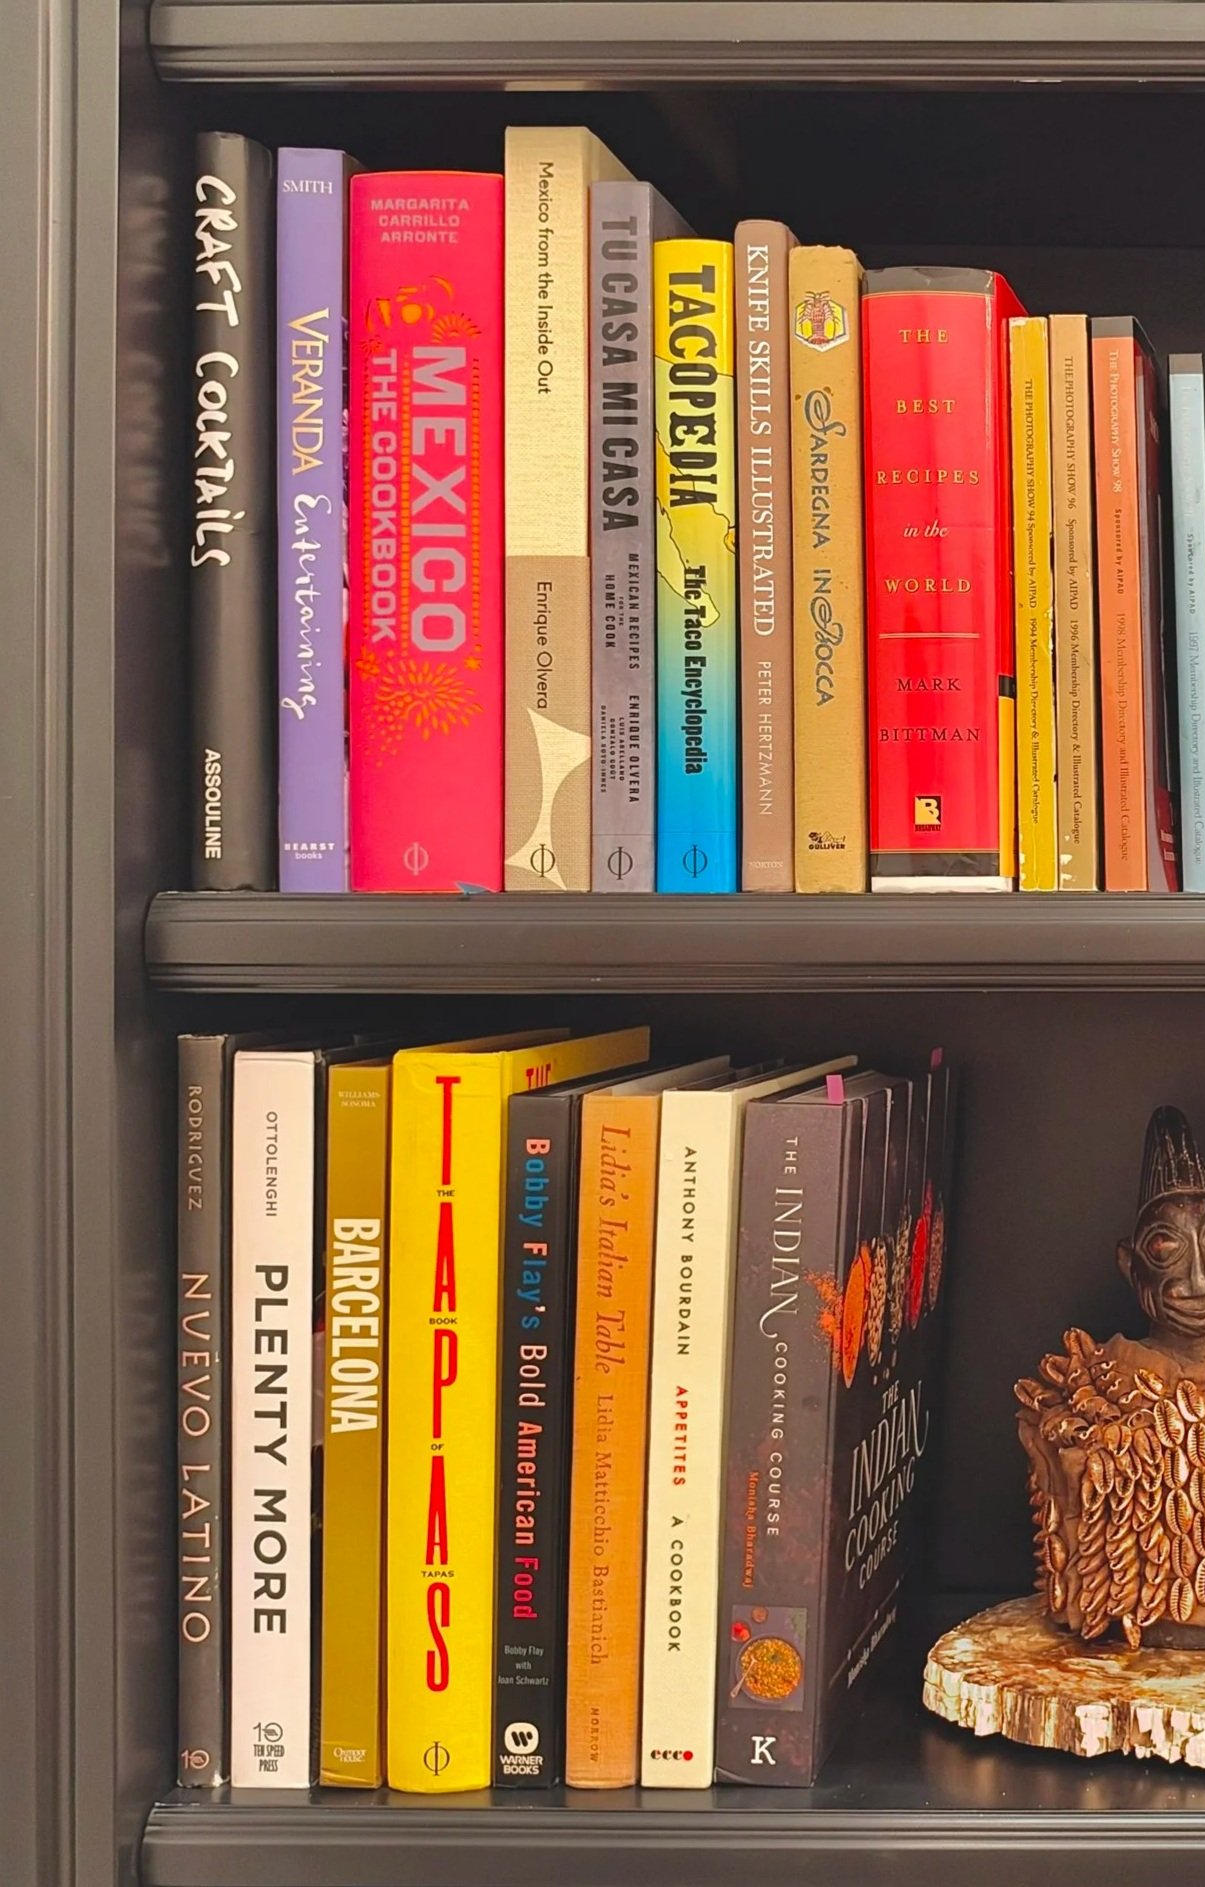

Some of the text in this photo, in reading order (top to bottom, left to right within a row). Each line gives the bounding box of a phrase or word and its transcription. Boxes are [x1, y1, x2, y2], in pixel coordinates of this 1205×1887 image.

[283, 180, 334, 195] SMITH
[371, 198, 470, 212] MARGARITA
[379, 214, 460, 228] CARRILLO
[381, 231, 458, 245] ARRONTE
[194, 175, 242, 328] CRAFT
[537, 162, 554, 396] Mexico from the Inside Out
[601, 216, 640, 532] TU CASA MI CASA
[668, 265, 719, 509] TACOPEDIA
[899, 329, 950, 344] THE
[747, 244, 775, 637] KNIFE SKILLS ILLUSTRATED
[897, 399, 956, 415] BEST
[281, 308, 332, 721] VERANDA Entertaining
[372, 349, 397, 643] THE COOKBOOK
[412, 346, 467, 653] MEXICO
[877, 470, 980, 486] RECIPES
[903, 519, 950, 538] in the
[804, 390, 847, 707] SARDEGNA IN BOCCA
[885, 578, 972, 594] WORLD
[1065, 356, 1083, 844] THE PHOTOGRAPHY SHOW 96 Sponsored by AIPAD 1996 Membership Directory & Illustrated Catalogue
[533, 581, 553, 710] Enrique Olvera
[605, 575, 617, 649] HOME COOK
[628, 553, 640, 671] MEXICAN RECIPES
[681, 565, 708, 775] The Taco Encyclopedia
[757, 661, 773, 816] PETER HERTZMANN
[880, 728, 981, 743] BITTMAN
[897, 677, 962, 692] MARK
[204, 749, 222, 860] ASSOULINE
[629, 695, 641, 804] ENRIQUE OLVERA
[265, 1111, 279, 1217] OTTOLENGHI
[437, 1189, 456, 1197] THE
[594, 1125, 632, 1374] Lidia's Italian Table
[677, 1146, 697, 1355] ANTHONY BOURDAIN
[329, 1218, 382, 1434] BARCELONA
[429, 1317, 458, 1325] BOOK
[512, 1138, 551, 1619] Bobby Flay's Bold American Food
[759, 1136, 804, 1537] THE INDIAN COOKING COURSE
[253, 1264, 290, 1635] PLENTY MORE
[431, 1443, 445, 1451] OF
[673, 1385, 689, 1486] APPETITES
[848, 1380, 930, 1521] INDIAN
[881, 1379, 899, 1414] THE
[181, 1273, 212, 1643] NUEVO LATINO
[844, 1456, 916, 1571] COOKING
[589, 1395, 614, 1665] Lidia Matticchio Bastianich
[668, 1515, 684, 1652] A COOKBOOK
[742, 1472, 759, 1589] Monisha Bharadwaj
[858, 1519, 899, 1590] COURSE
